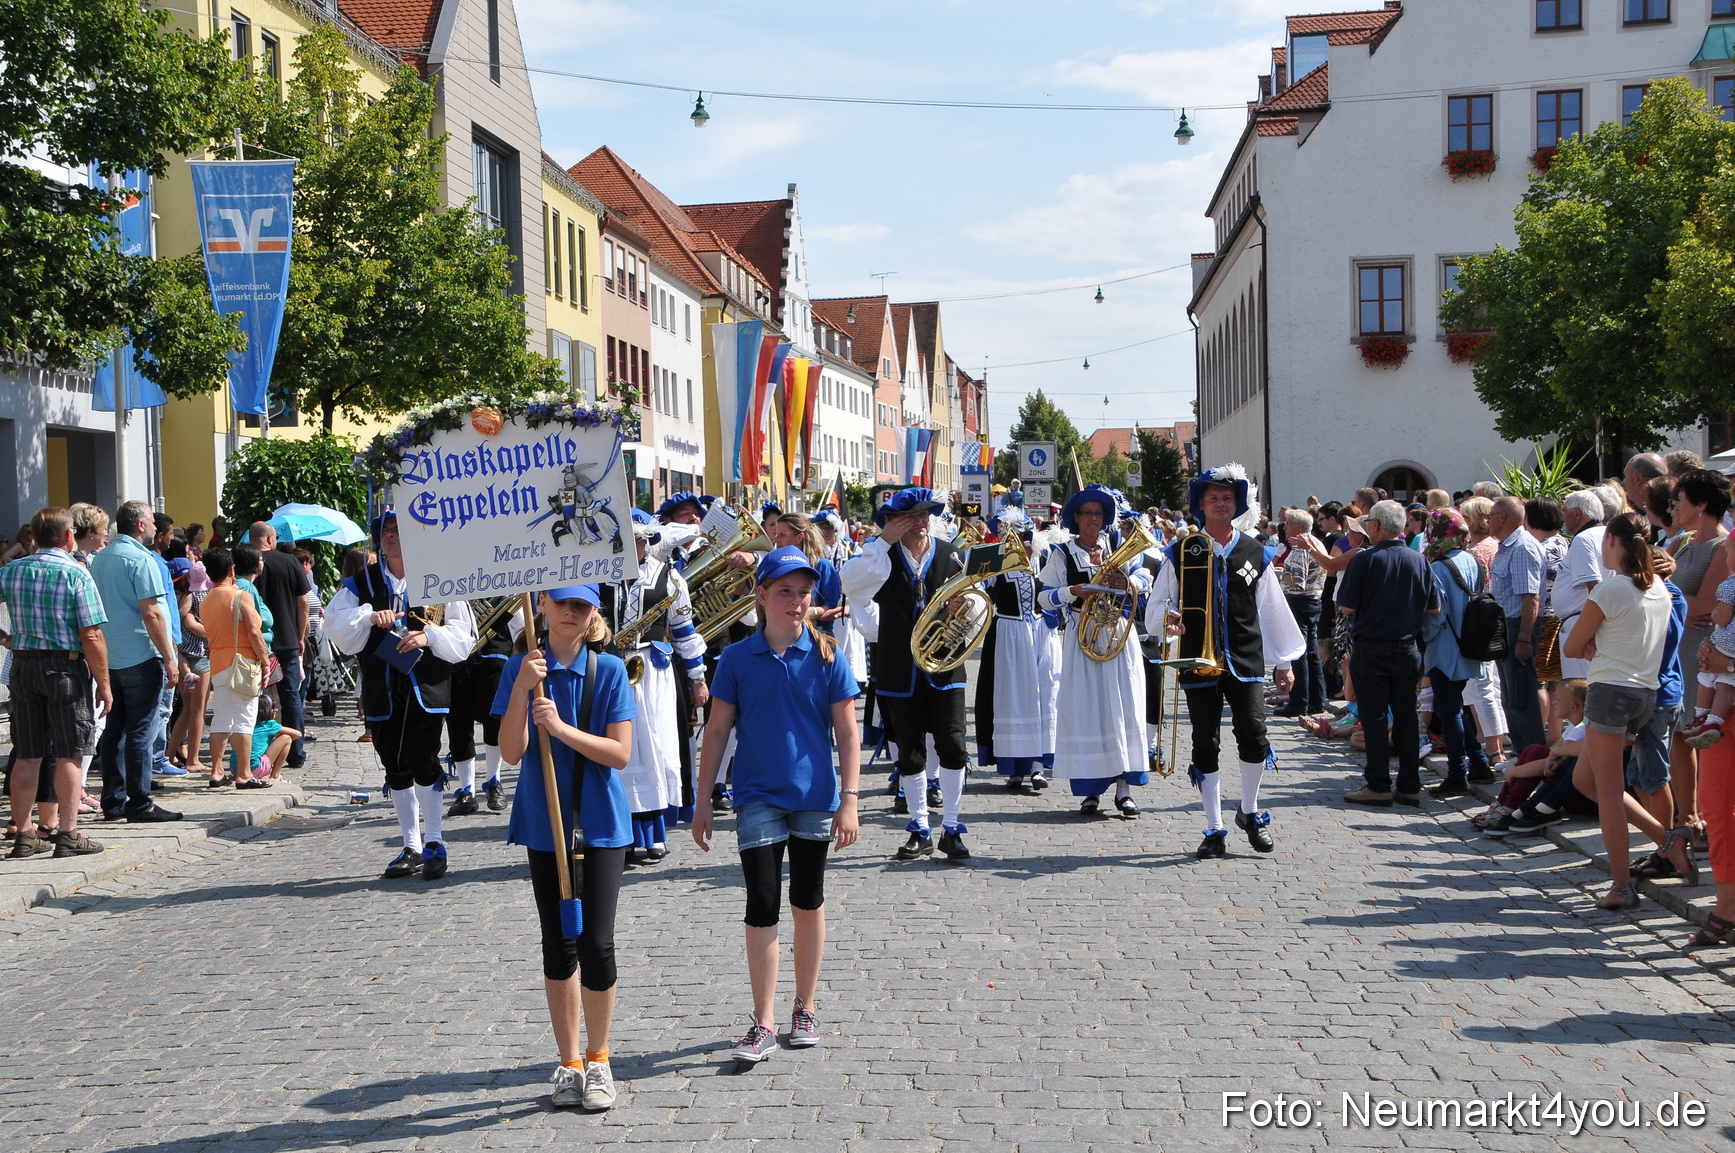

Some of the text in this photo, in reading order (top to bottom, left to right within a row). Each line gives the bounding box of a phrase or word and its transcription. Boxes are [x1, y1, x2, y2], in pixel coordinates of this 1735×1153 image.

[216, 292, 252, 302] eumarkt
[400, 431, 578, 485] Blaskapelle
[408, 479, 540, 532] Eppelein
[493, 540, 547, 563] Markt
[421, 554, 625, 600] Postbauer-Heng
